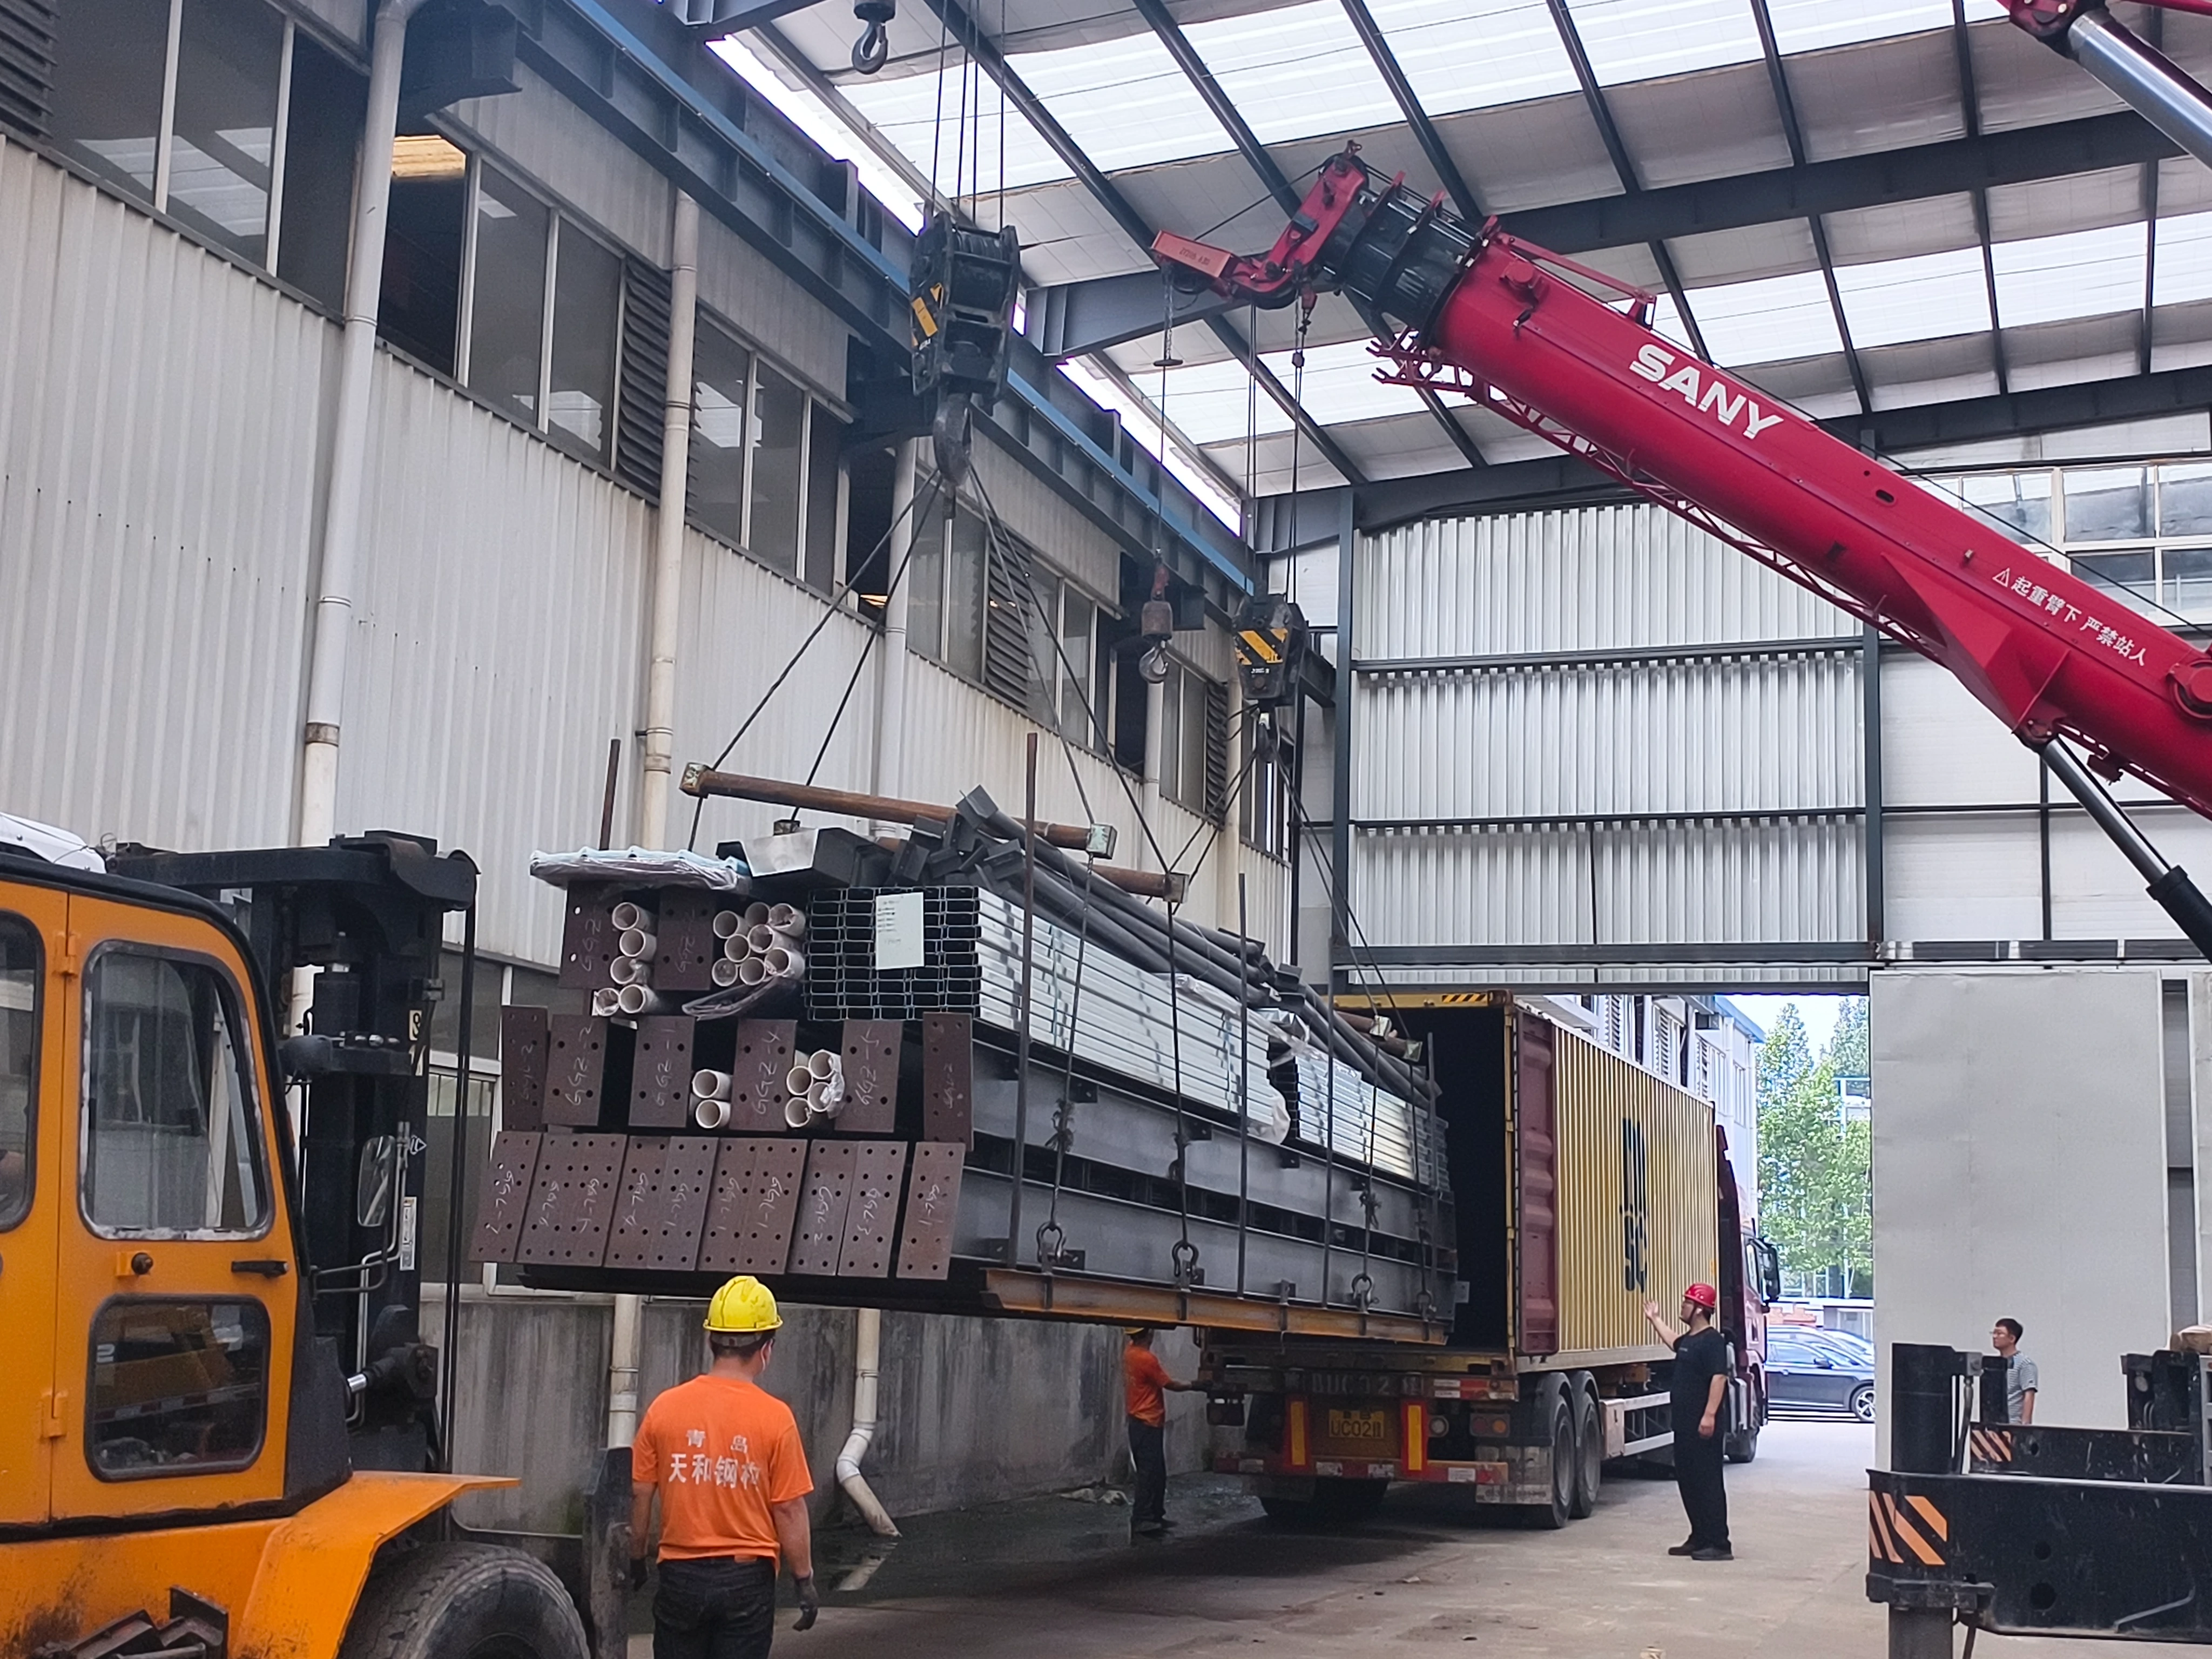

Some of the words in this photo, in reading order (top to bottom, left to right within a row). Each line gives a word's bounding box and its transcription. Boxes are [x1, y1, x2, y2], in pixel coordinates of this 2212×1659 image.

[1629, 342, 1784, 440] SANY
[2011, 576, 2082, 623] 起重臂下
[2080, 616, 2147, 666] 严禁站人
